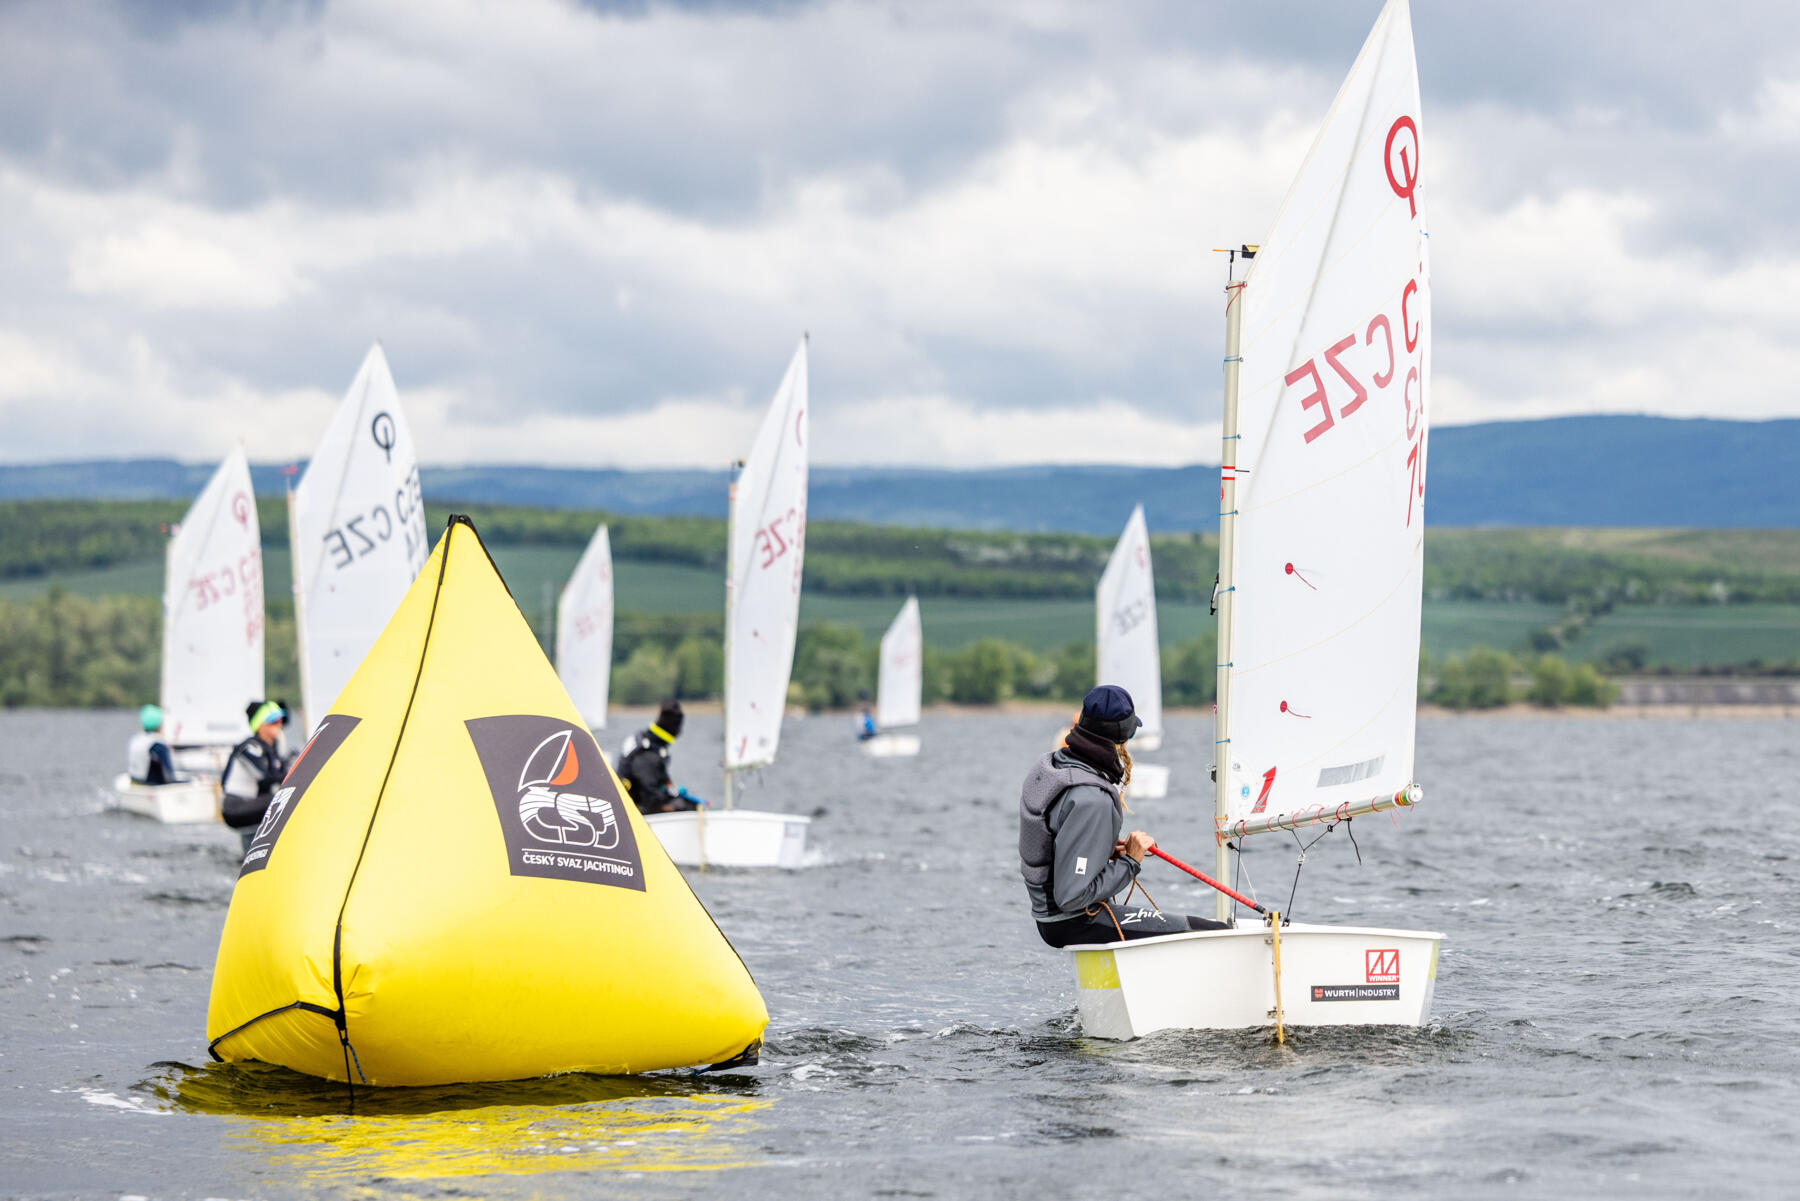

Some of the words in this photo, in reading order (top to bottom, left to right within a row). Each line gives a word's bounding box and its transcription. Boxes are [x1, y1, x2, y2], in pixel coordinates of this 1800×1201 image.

[522, 851, 555, 866] ČESKÝ
[557, 857, 582, 869] SVAZ
[584, 860, 634, 877] JACHTINGU
[1359, 988, 1396, 997] INDUSTRY
